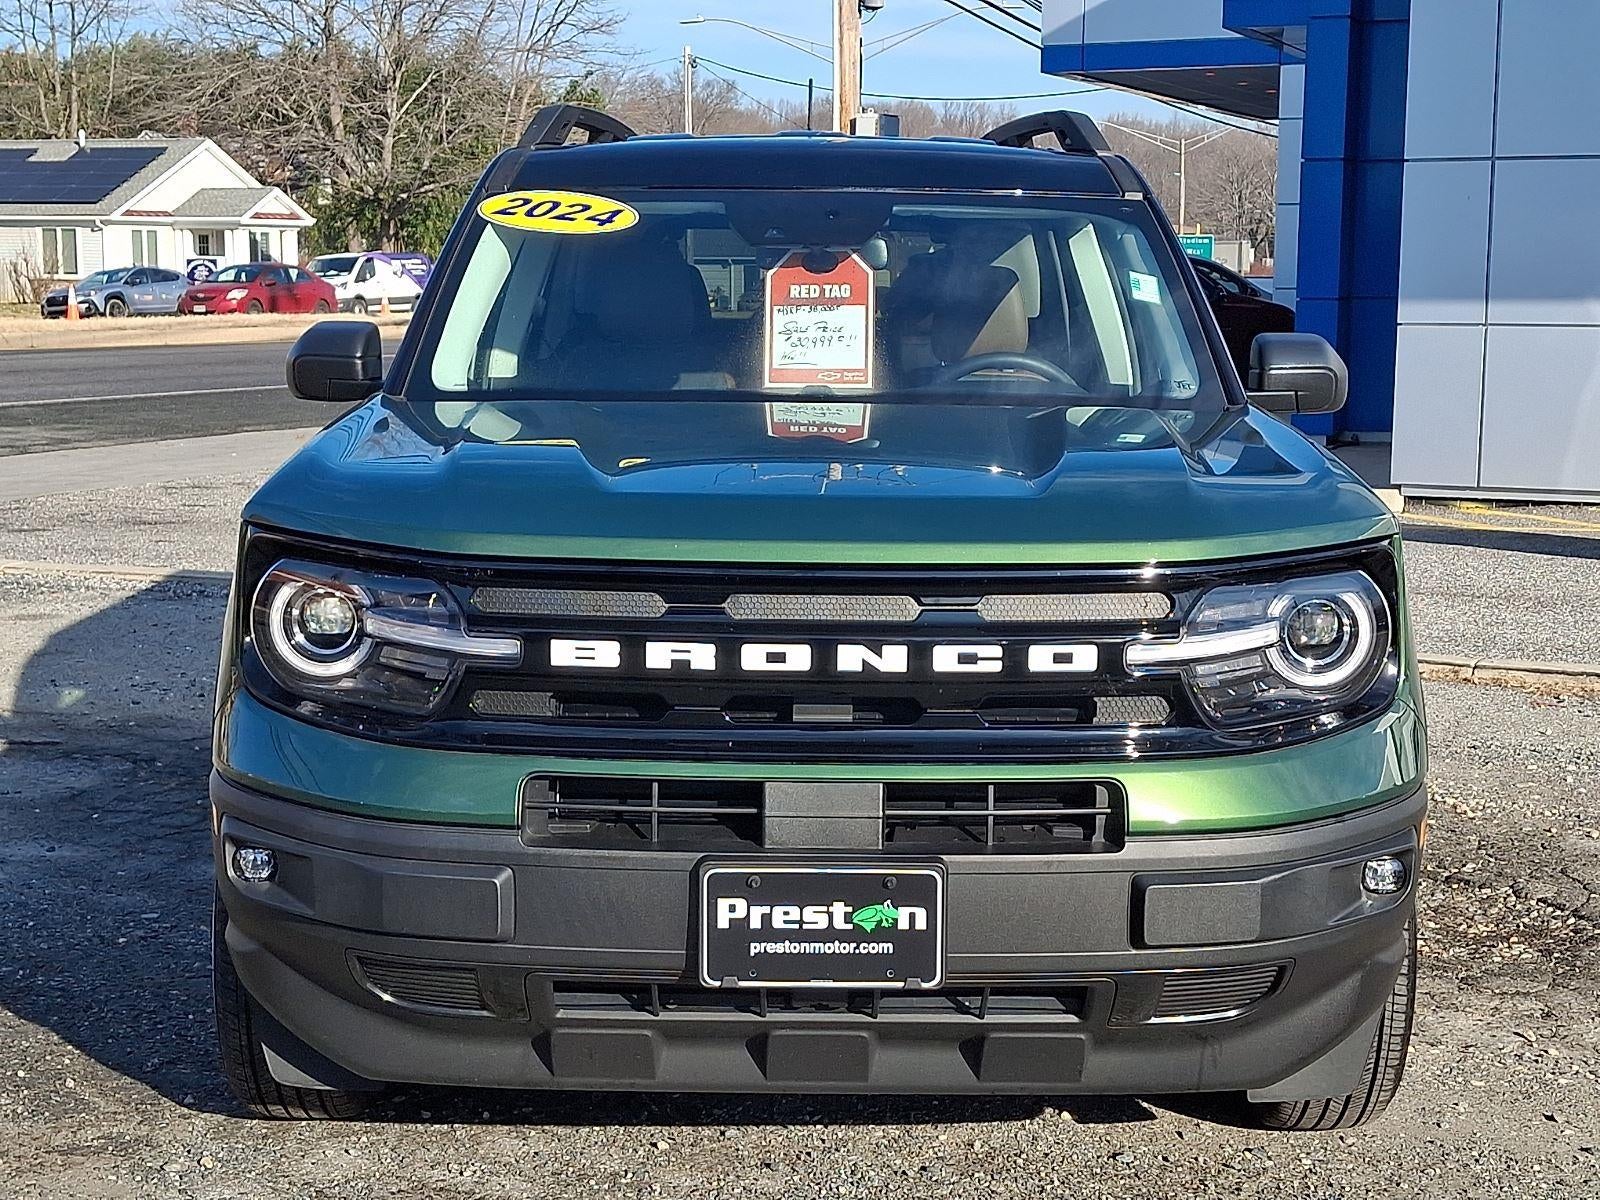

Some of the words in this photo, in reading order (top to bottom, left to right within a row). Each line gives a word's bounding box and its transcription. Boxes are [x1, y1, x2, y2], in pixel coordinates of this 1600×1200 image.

[490, 197, 625, 227] 2024
[789, 284, 820, 298] RED
[822, 284, 851, 298] TAG
[549, 638, 1098, 673] BRONCO
[749, 939, 894, 957] prestonmotor.com
